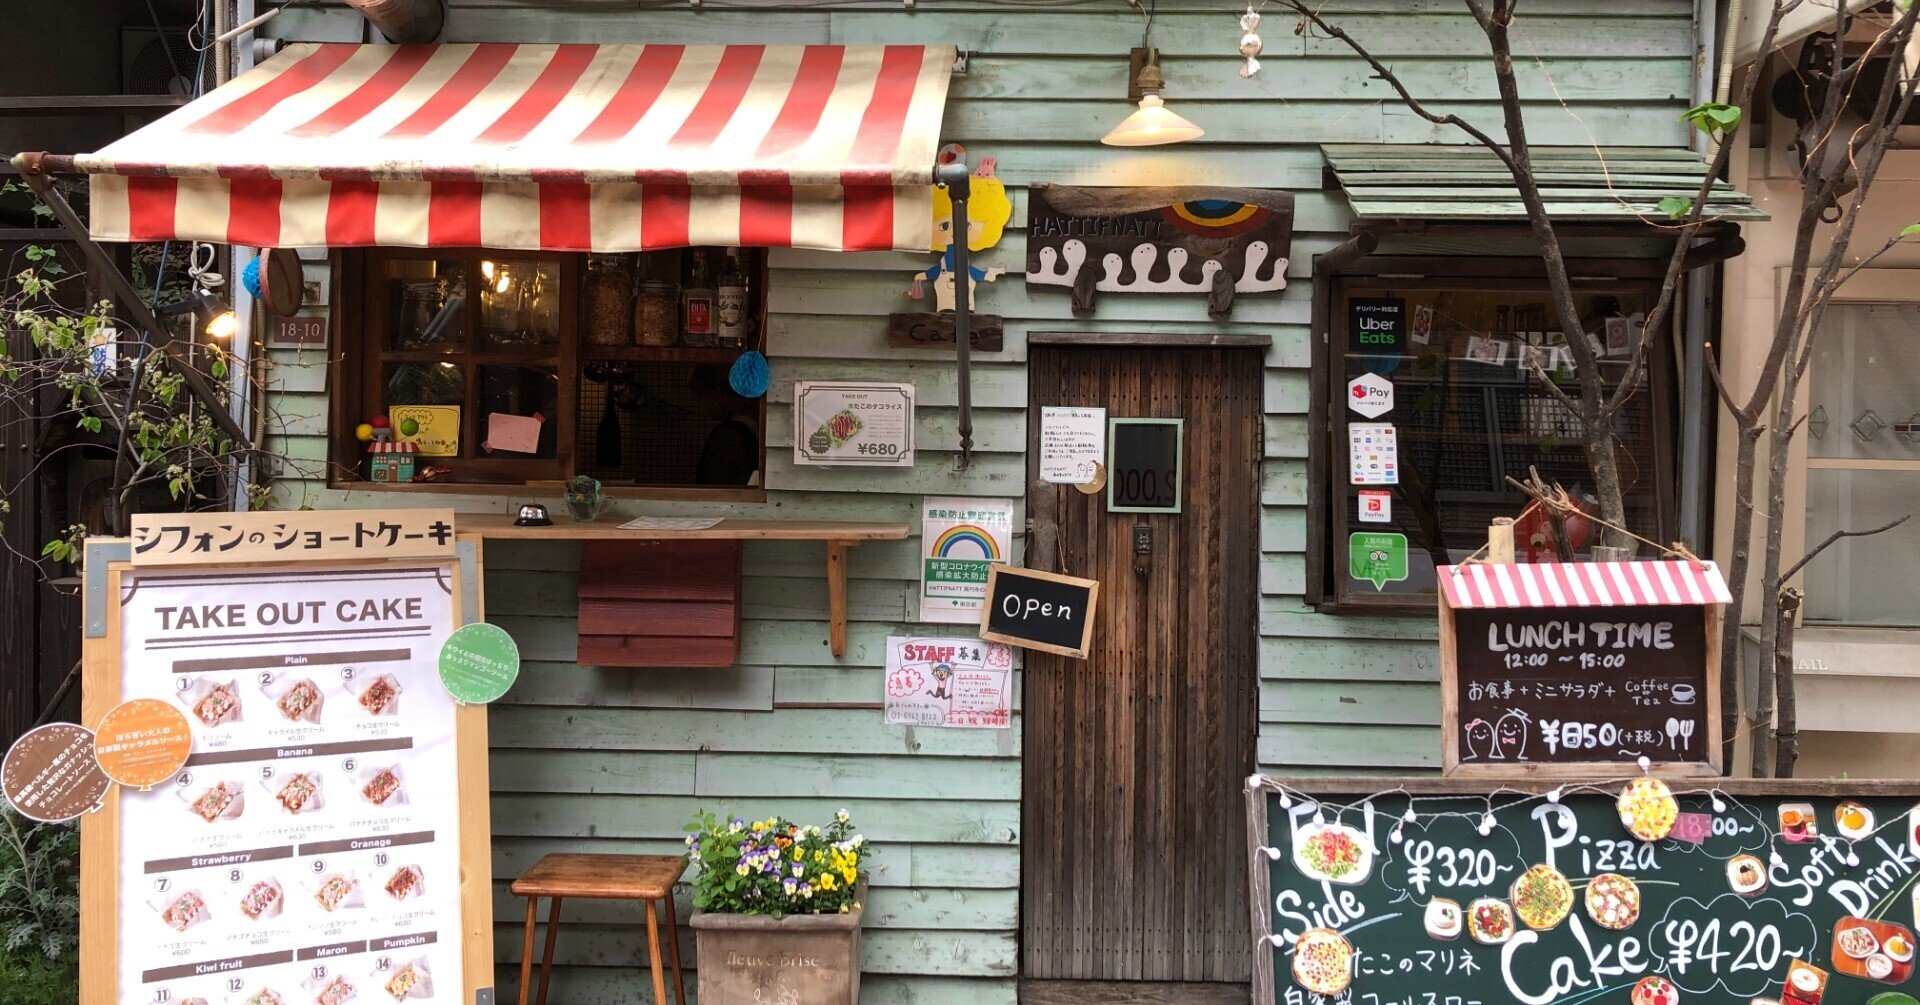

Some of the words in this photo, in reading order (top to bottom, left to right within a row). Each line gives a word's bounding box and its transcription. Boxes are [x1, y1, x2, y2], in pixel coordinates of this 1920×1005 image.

[1032, 217, 1165, 238] HATTIFNATT
[280, 322, 320, 337] 18-10
[1360, 318, 1395, 331] Uber
[909, 324, 979, 345] Cae
[1360, 331, 1396, 344] Eats
[1370, 387, 1390, 399] Pay
[858, 443, 897, 455] ¥680
[134, 520, 452, 554] シフォンのショートケーキ
[154, 604, 246, 631] TAKE
[256, 600, 327, 626] OUT
[336, 597, 423, 622] CAKE
[1003, 593, 1072, 620] Open
[1488, 620, 1585, 651] LUNCH
[1589, 621, 1675, 650] TIME
[285, 655, 308, 665] Plain
[904, 644, 955, 663] STAFF
[1504, 653, 1548, 669] 12:00
[1579, 652, 1626, 669] 15:00
[1793, 658, 1828, 671] AIL
[1625, 679, 1669, 693] Coffee
[277, 748, 313, 758] Banana
[351, 839, 391, 849] Oranage
[1531, 802, 1661, 875] Pizza
[191, 852, 251, 867] Strawberry
[1768, 833, 1847, 906] Soft
[1827, 836, 1917, 919] Drink
[1275, 879, 1365, 945] Side
[384, 935, 426, 948] Pumpkin
[316, 946, 348, 957] Maron
[1501, 913, 1648, 1005] Cake
[195, 963, 217, 974] Kiwi
[219, 960, 243, 970] fruit
[1353, 946, 1481, 978] たこのマリネ
